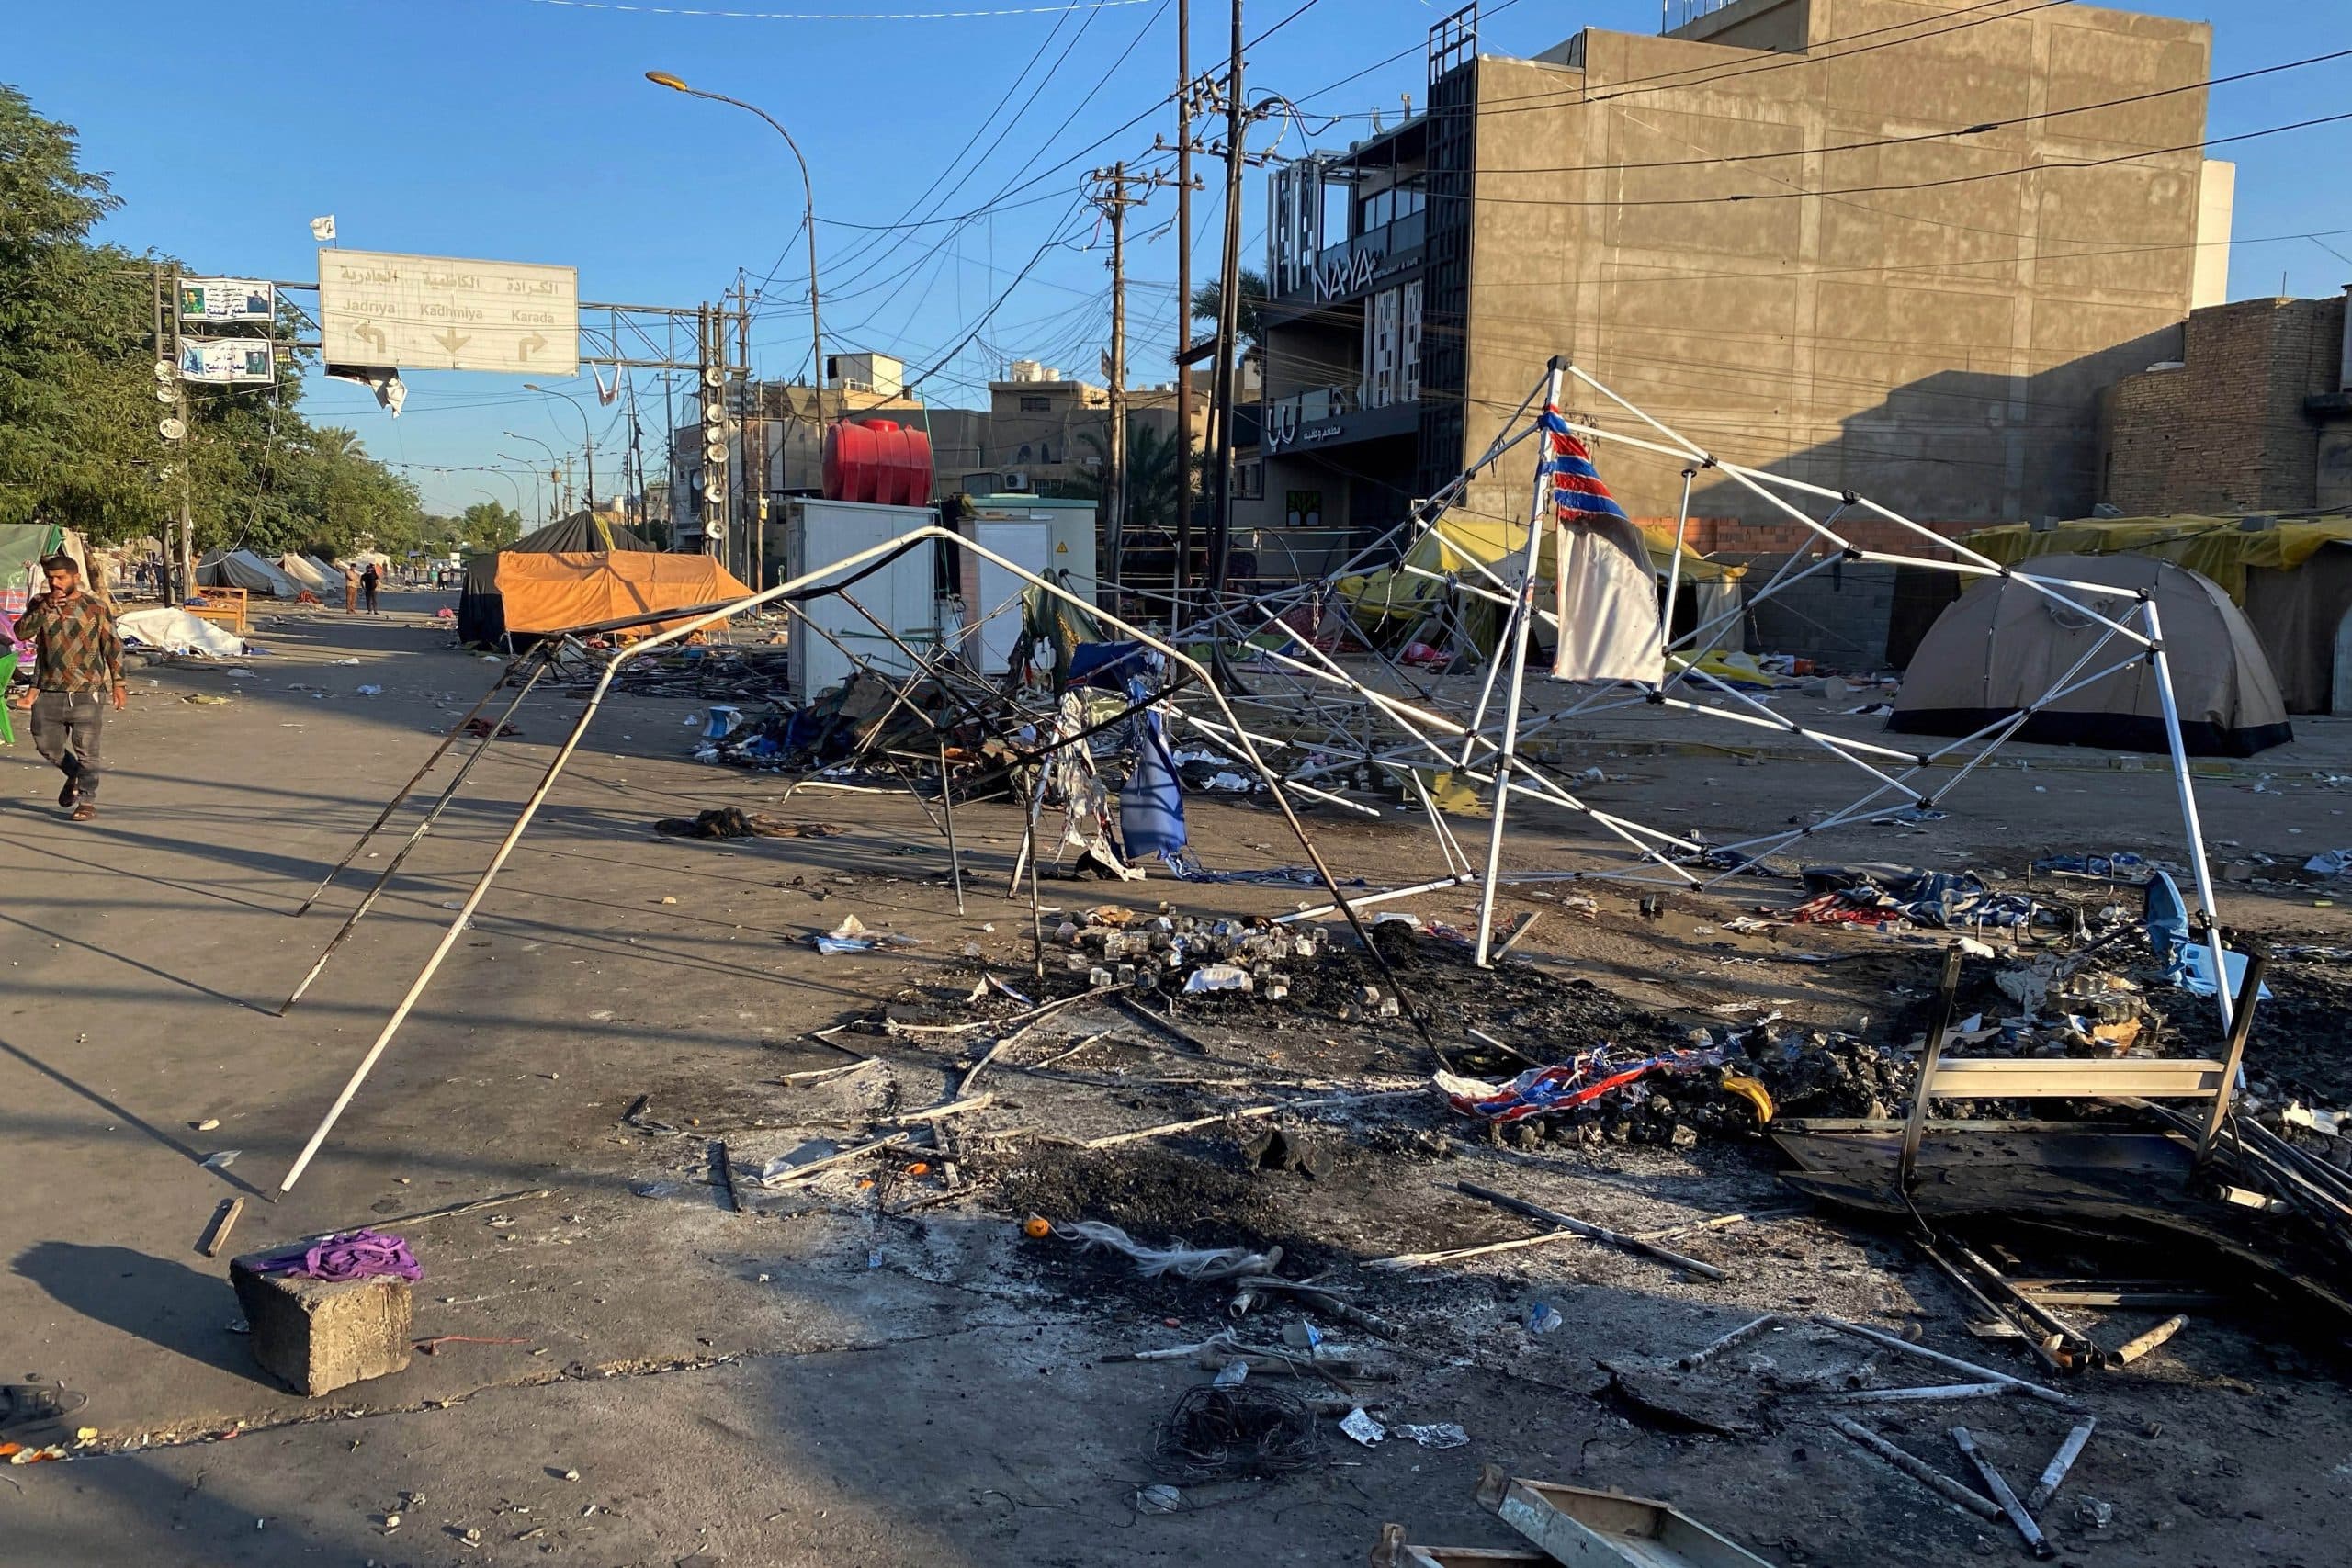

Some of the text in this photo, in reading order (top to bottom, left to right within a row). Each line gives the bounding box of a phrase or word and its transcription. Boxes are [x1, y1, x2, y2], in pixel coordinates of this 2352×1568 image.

[341, 265, 398, 286] الجادرية
[507, 277, 559, 295] الكرادة
[1314, 248, 1373, 305] NAYA
[343, 298, 555, 324] Jadriya Kadhmiya Karada
